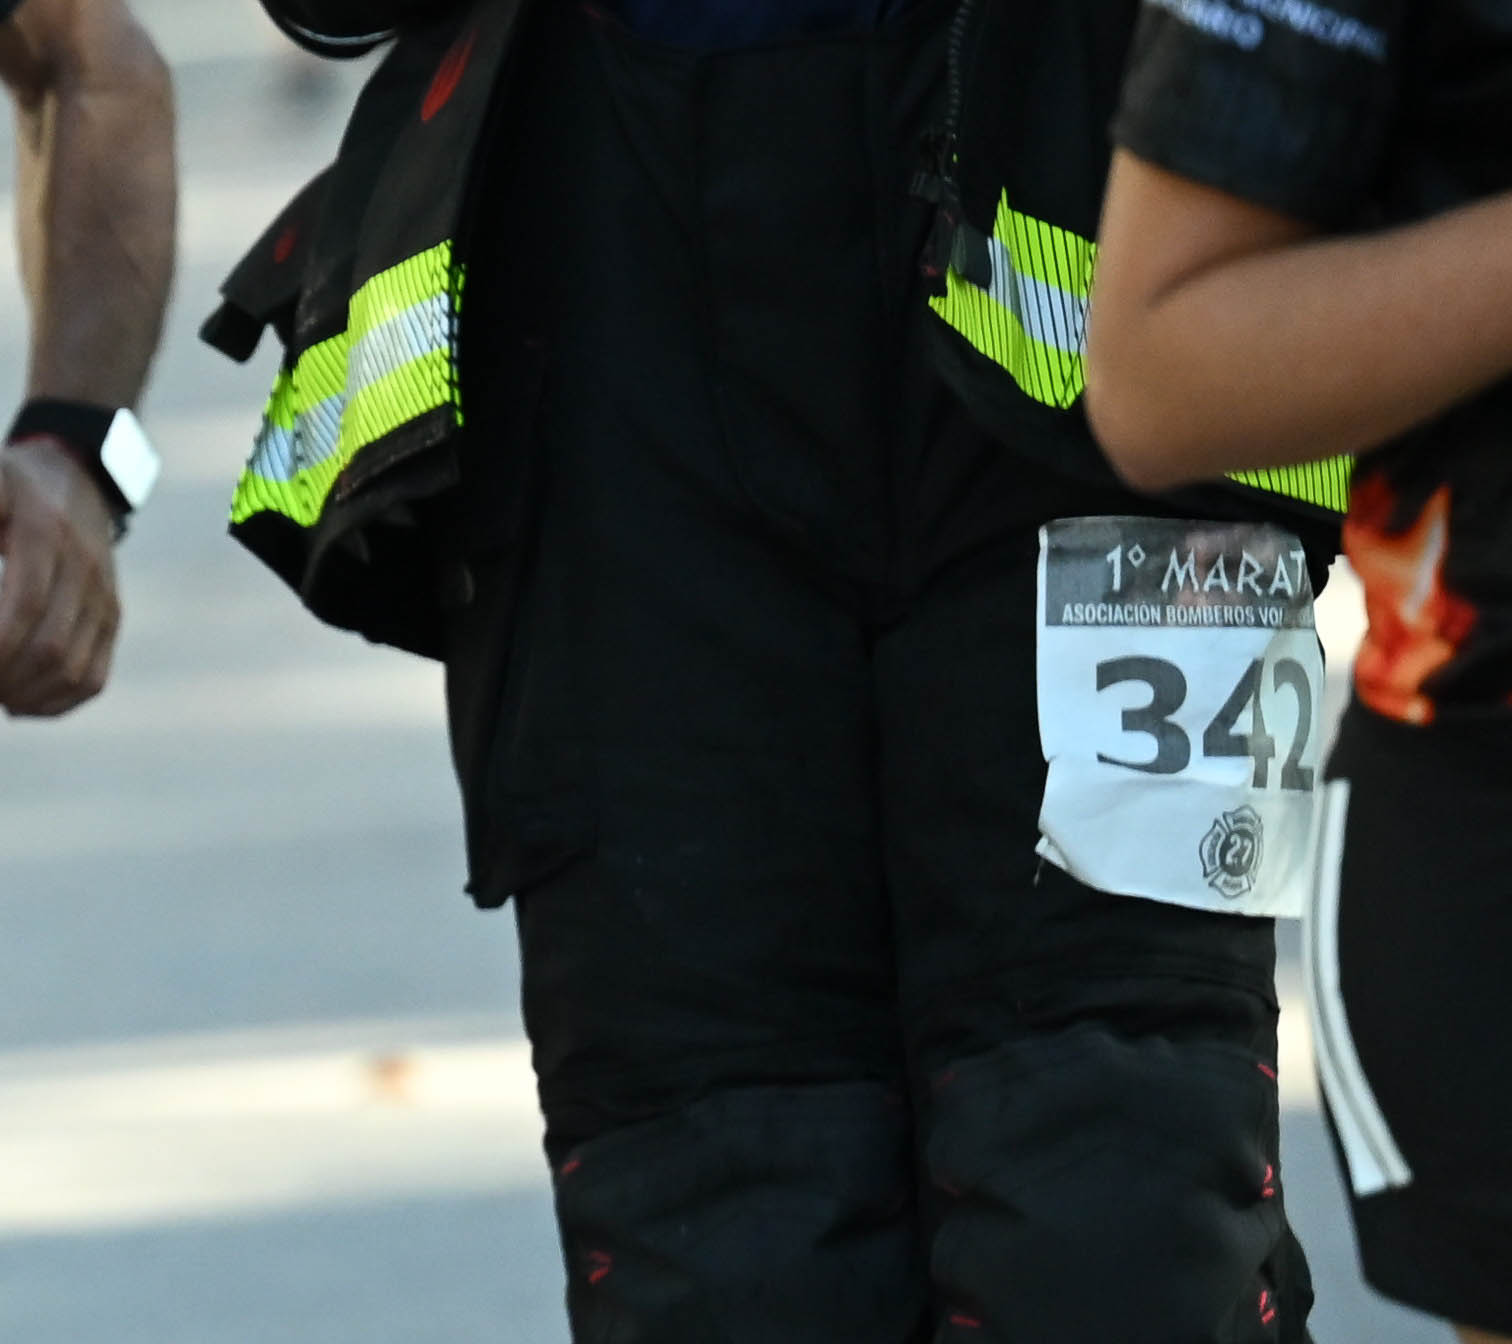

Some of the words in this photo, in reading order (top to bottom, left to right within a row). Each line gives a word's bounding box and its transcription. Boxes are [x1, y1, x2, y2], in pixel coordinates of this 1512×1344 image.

[1062, 601, 1161, 625] ASOCIACIÓN
[1167, 605, 1255, 626] BOMBEROS
[1096, 656, 1314, 792] 342
